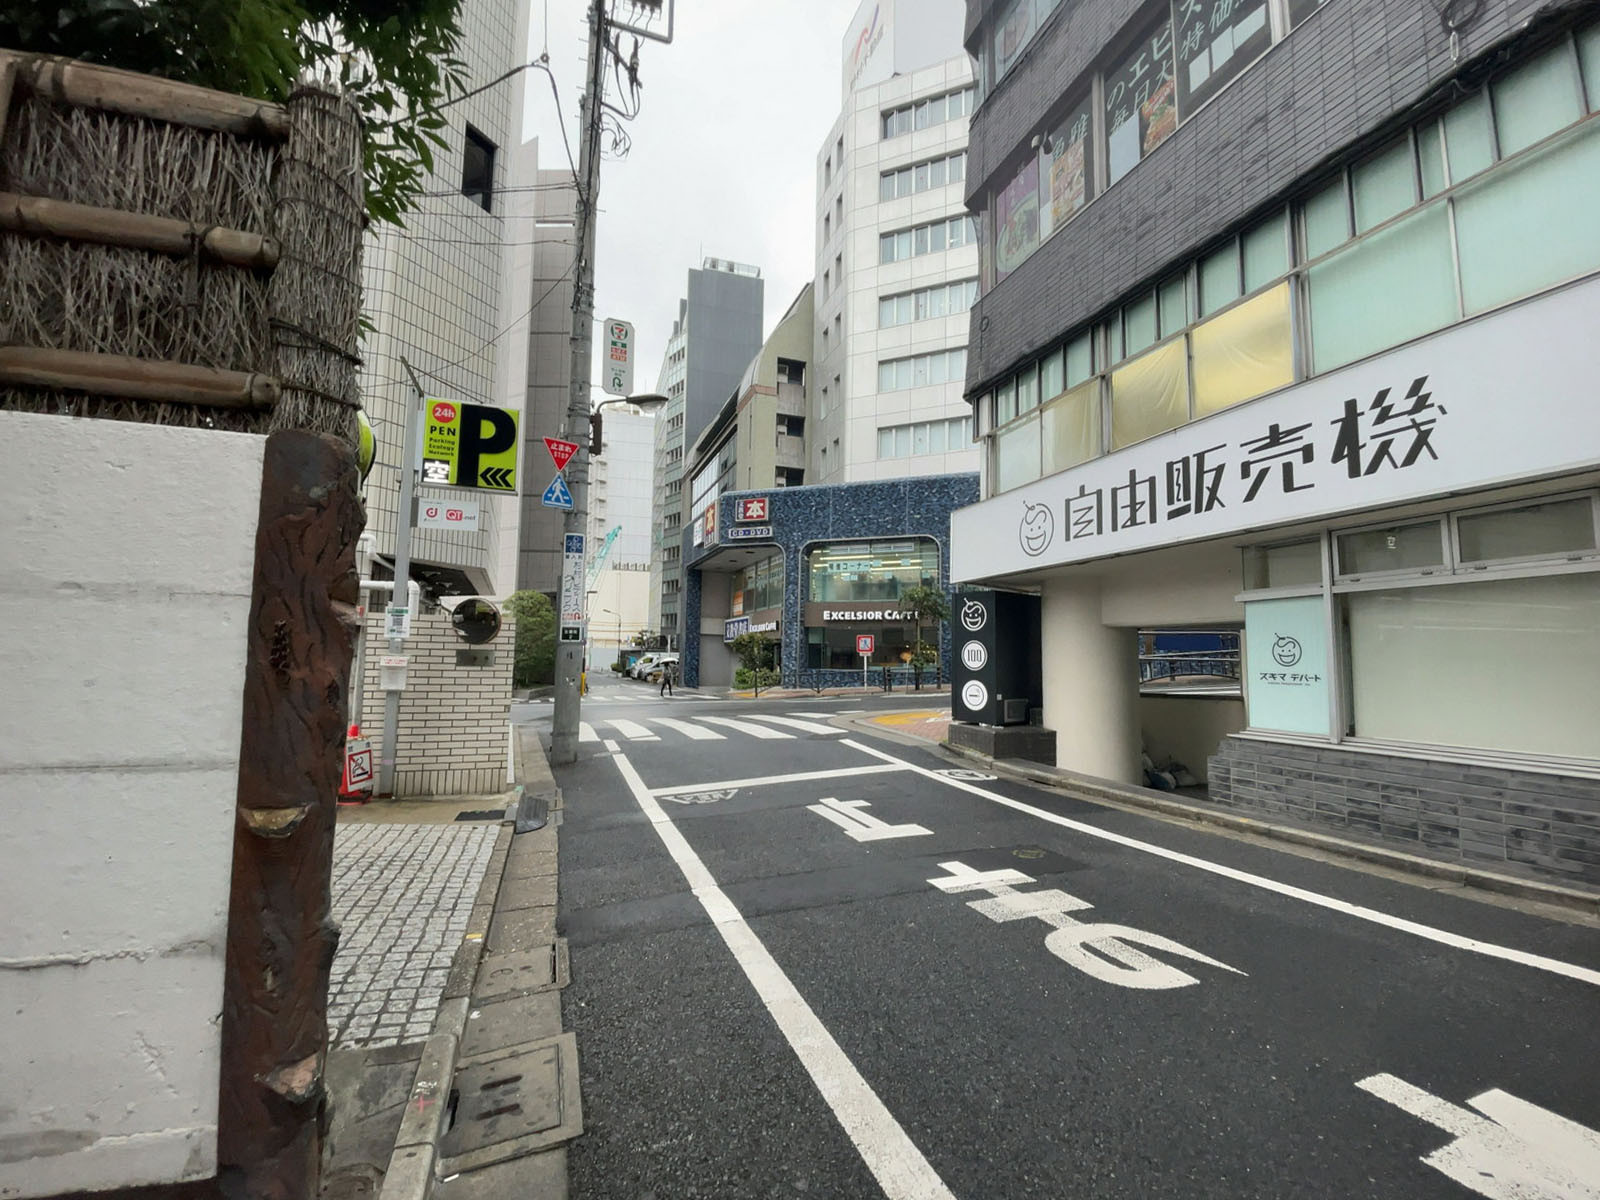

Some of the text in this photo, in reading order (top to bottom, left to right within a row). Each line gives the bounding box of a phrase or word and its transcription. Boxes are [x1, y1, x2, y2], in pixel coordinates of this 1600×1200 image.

[434, 407, 455, 418] 24h
[430, 425, 456, 436] PEN
[456, 403, 516, 488] P
[1065, 375, 1448, 542] 自由販売機
[423, 460, 450, 484] 空
[823, 610, 883, 620] EXCELSIOR
[967, 649, 982, 662] 100
[1260, 672, 1322, 682] スキマ デパート
